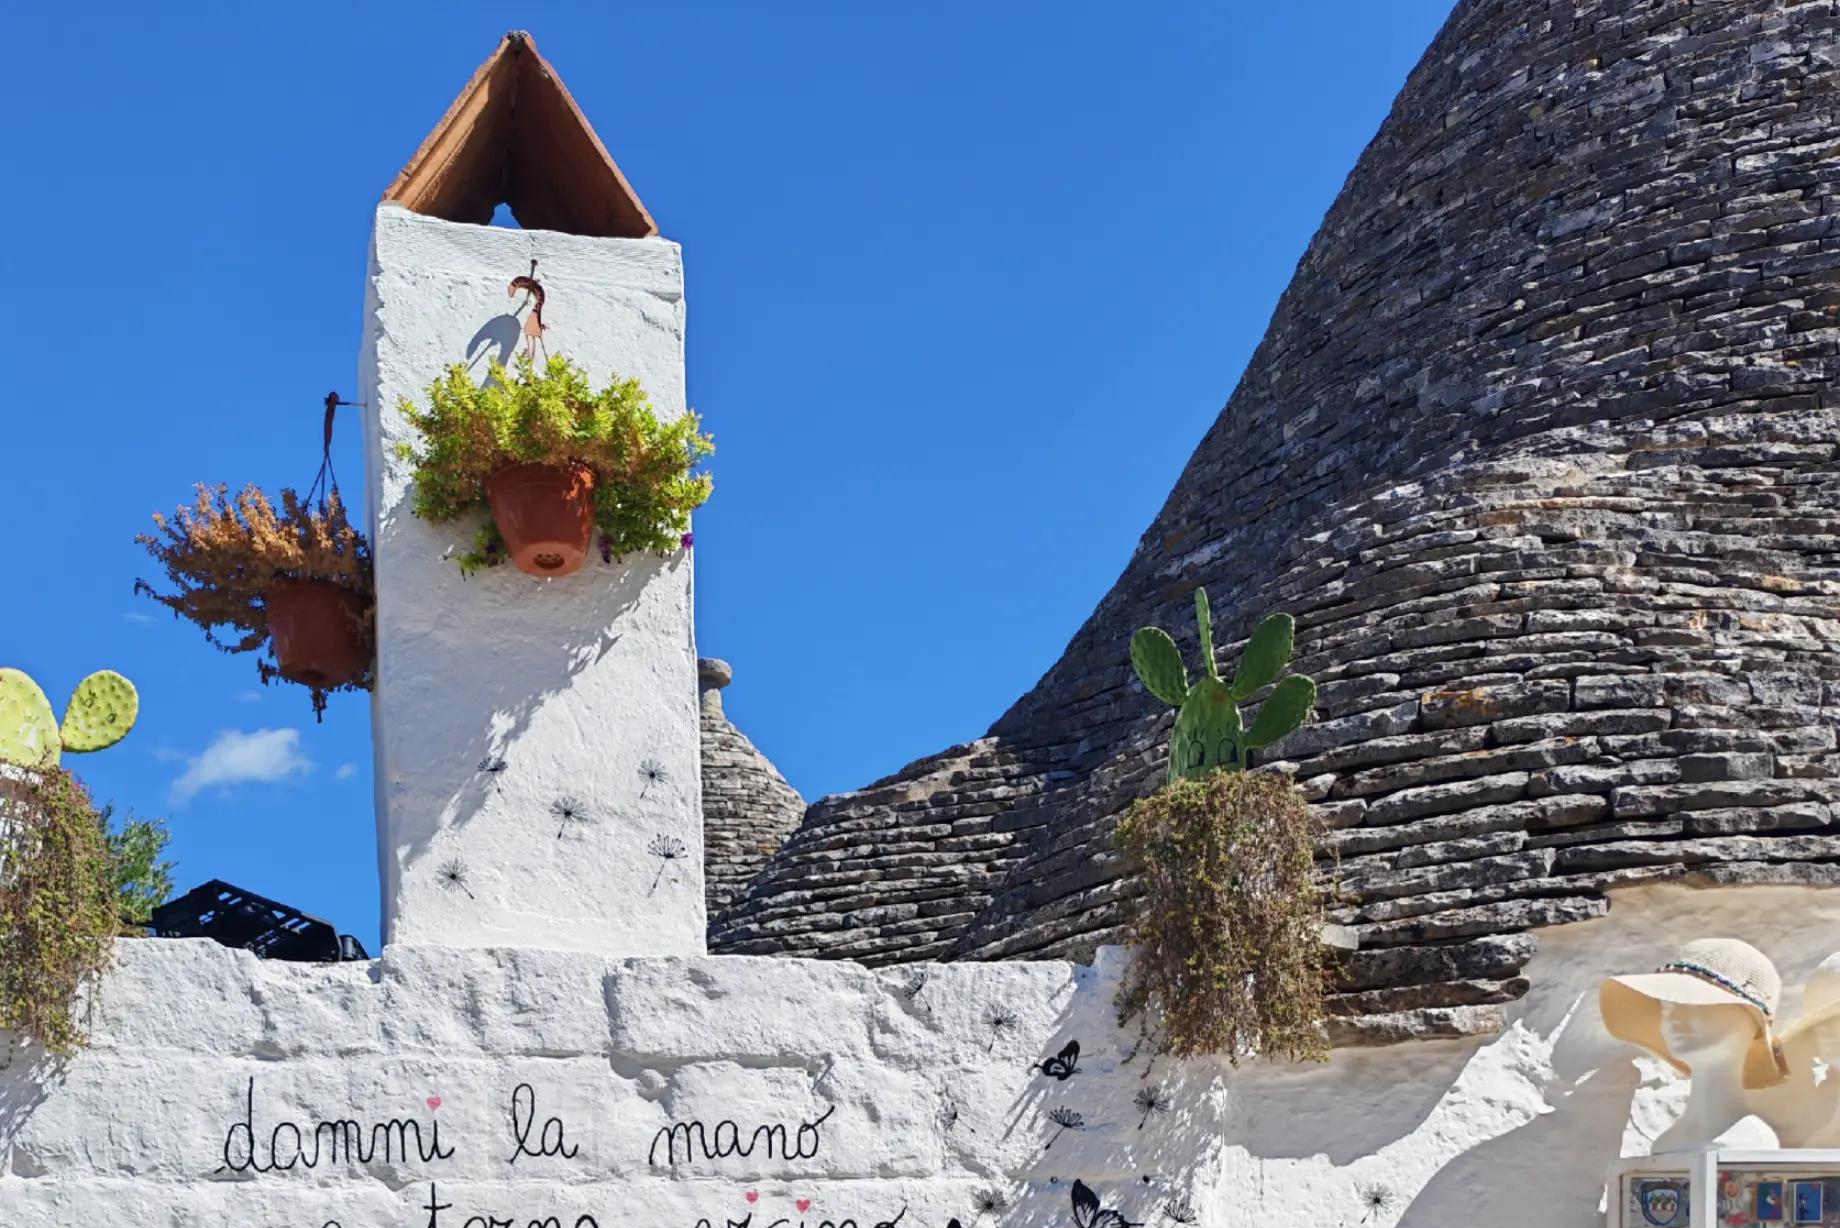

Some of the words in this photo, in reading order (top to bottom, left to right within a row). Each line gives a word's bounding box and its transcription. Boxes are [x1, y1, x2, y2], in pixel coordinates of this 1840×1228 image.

[214, 1076, 456, 1174] dammi
[510, 1083, 580, 1163] la
[648, 1105, 835, 1166] mano
